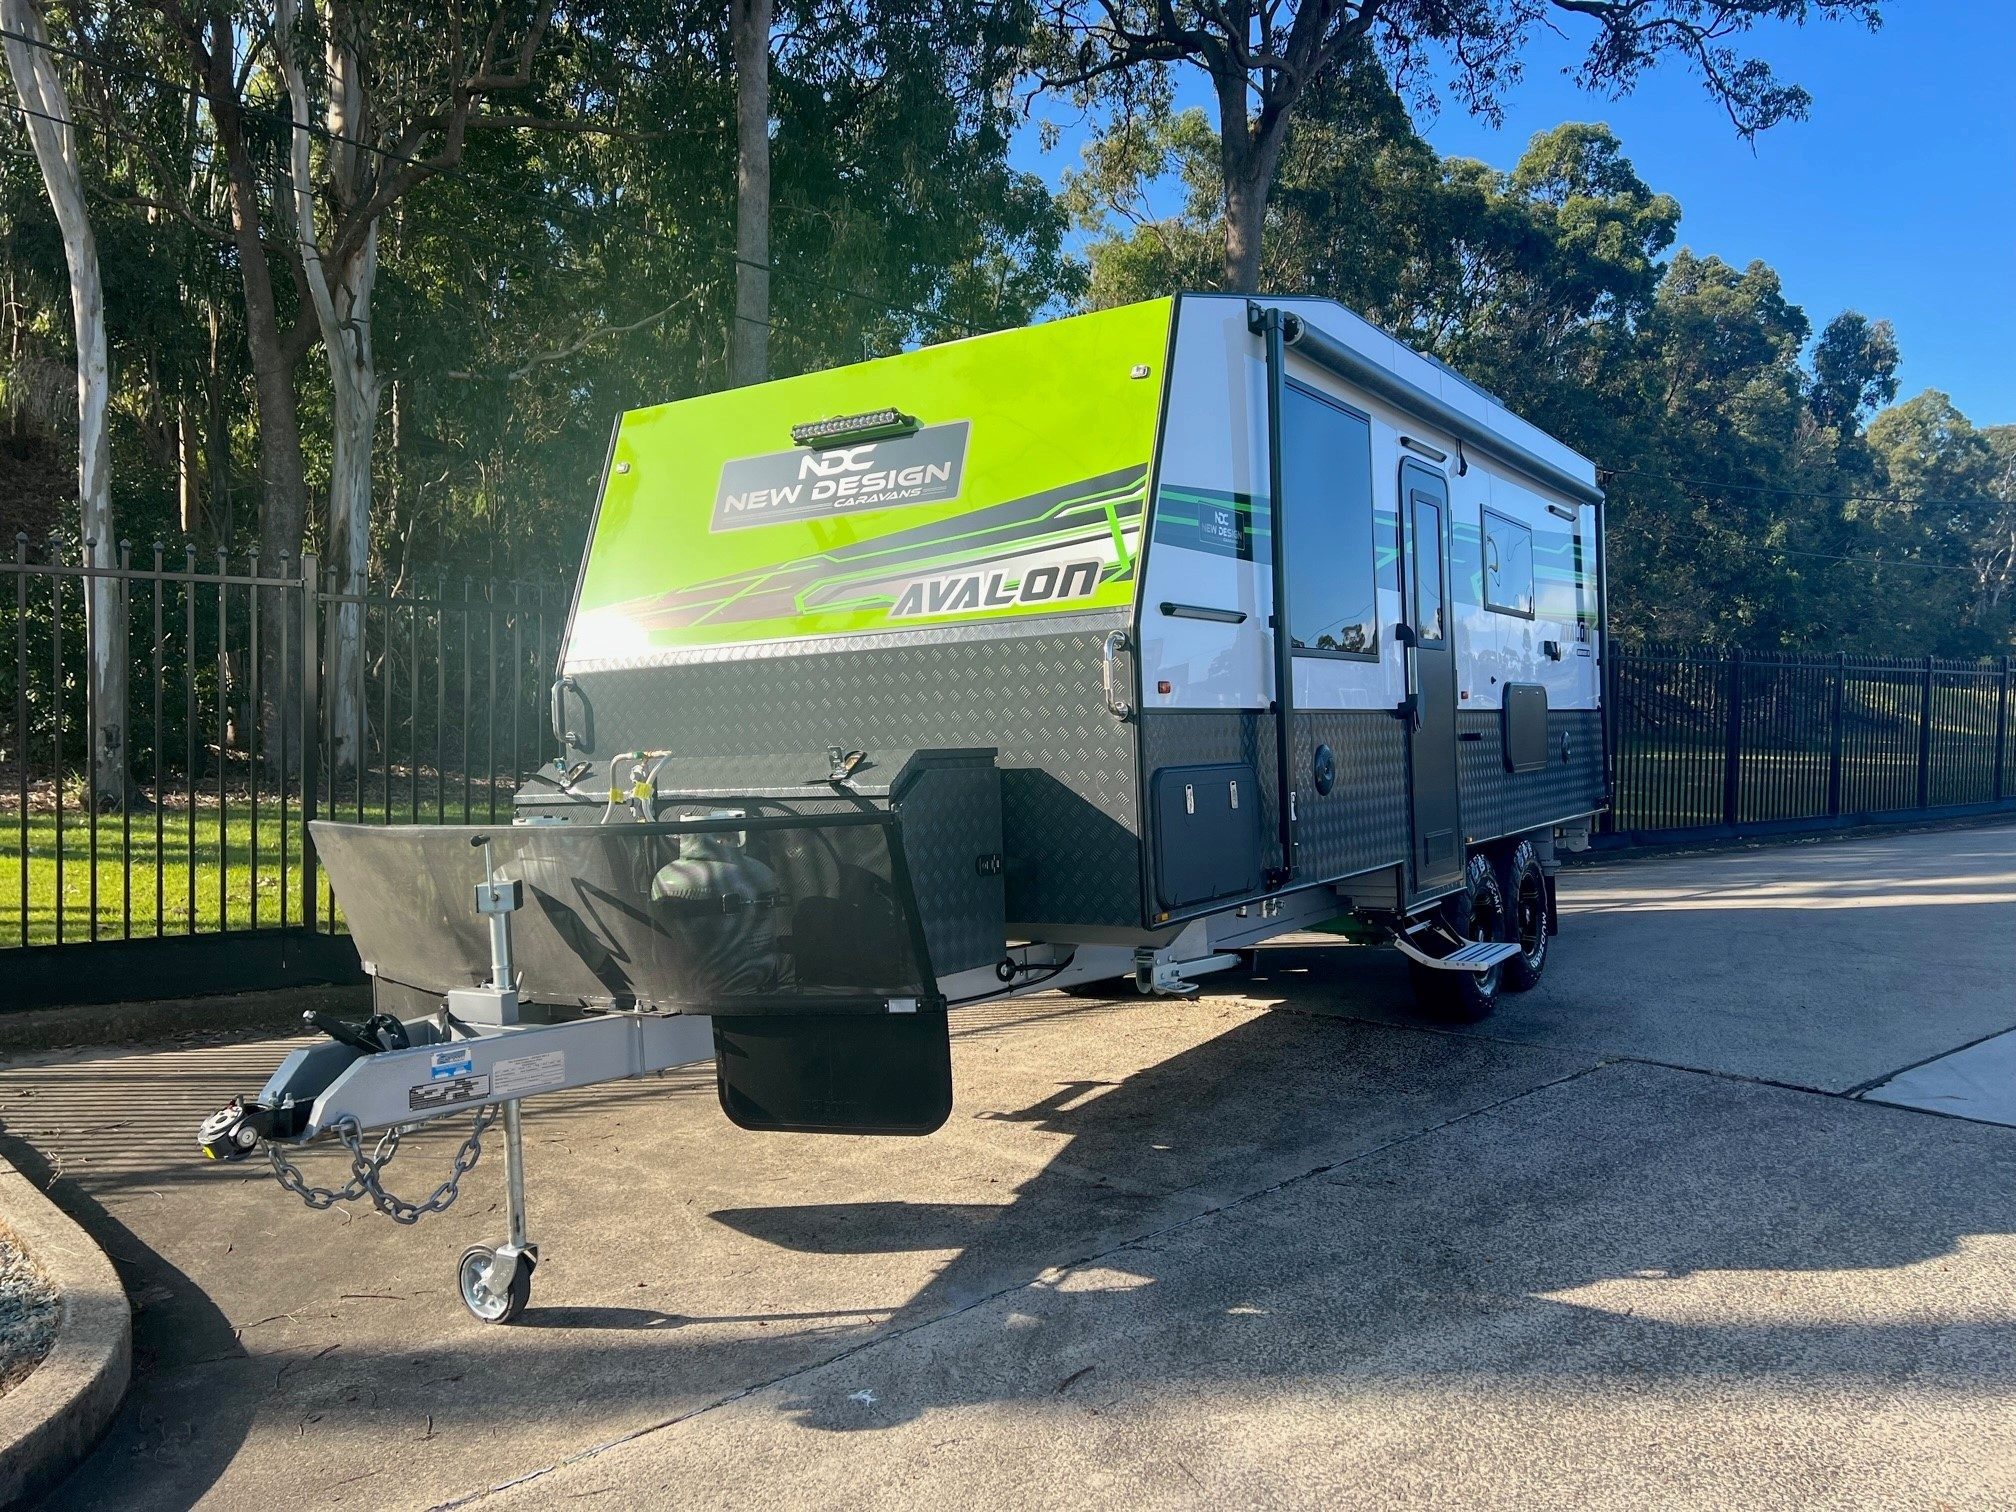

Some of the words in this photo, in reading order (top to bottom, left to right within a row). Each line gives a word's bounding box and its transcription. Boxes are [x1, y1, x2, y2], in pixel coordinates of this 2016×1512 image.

[798, 444, 877, 479] NDC
[723, 485, 802, 513] NEW
[811, 462, 951, 500] DESIGN
[833, 488, 922, 508] CARAVANS
[1203, 522, 1217, 534] NEW
[1218, 527, 1242, 540] DESIGN
[890, 561, 1099, 616] AVALON
